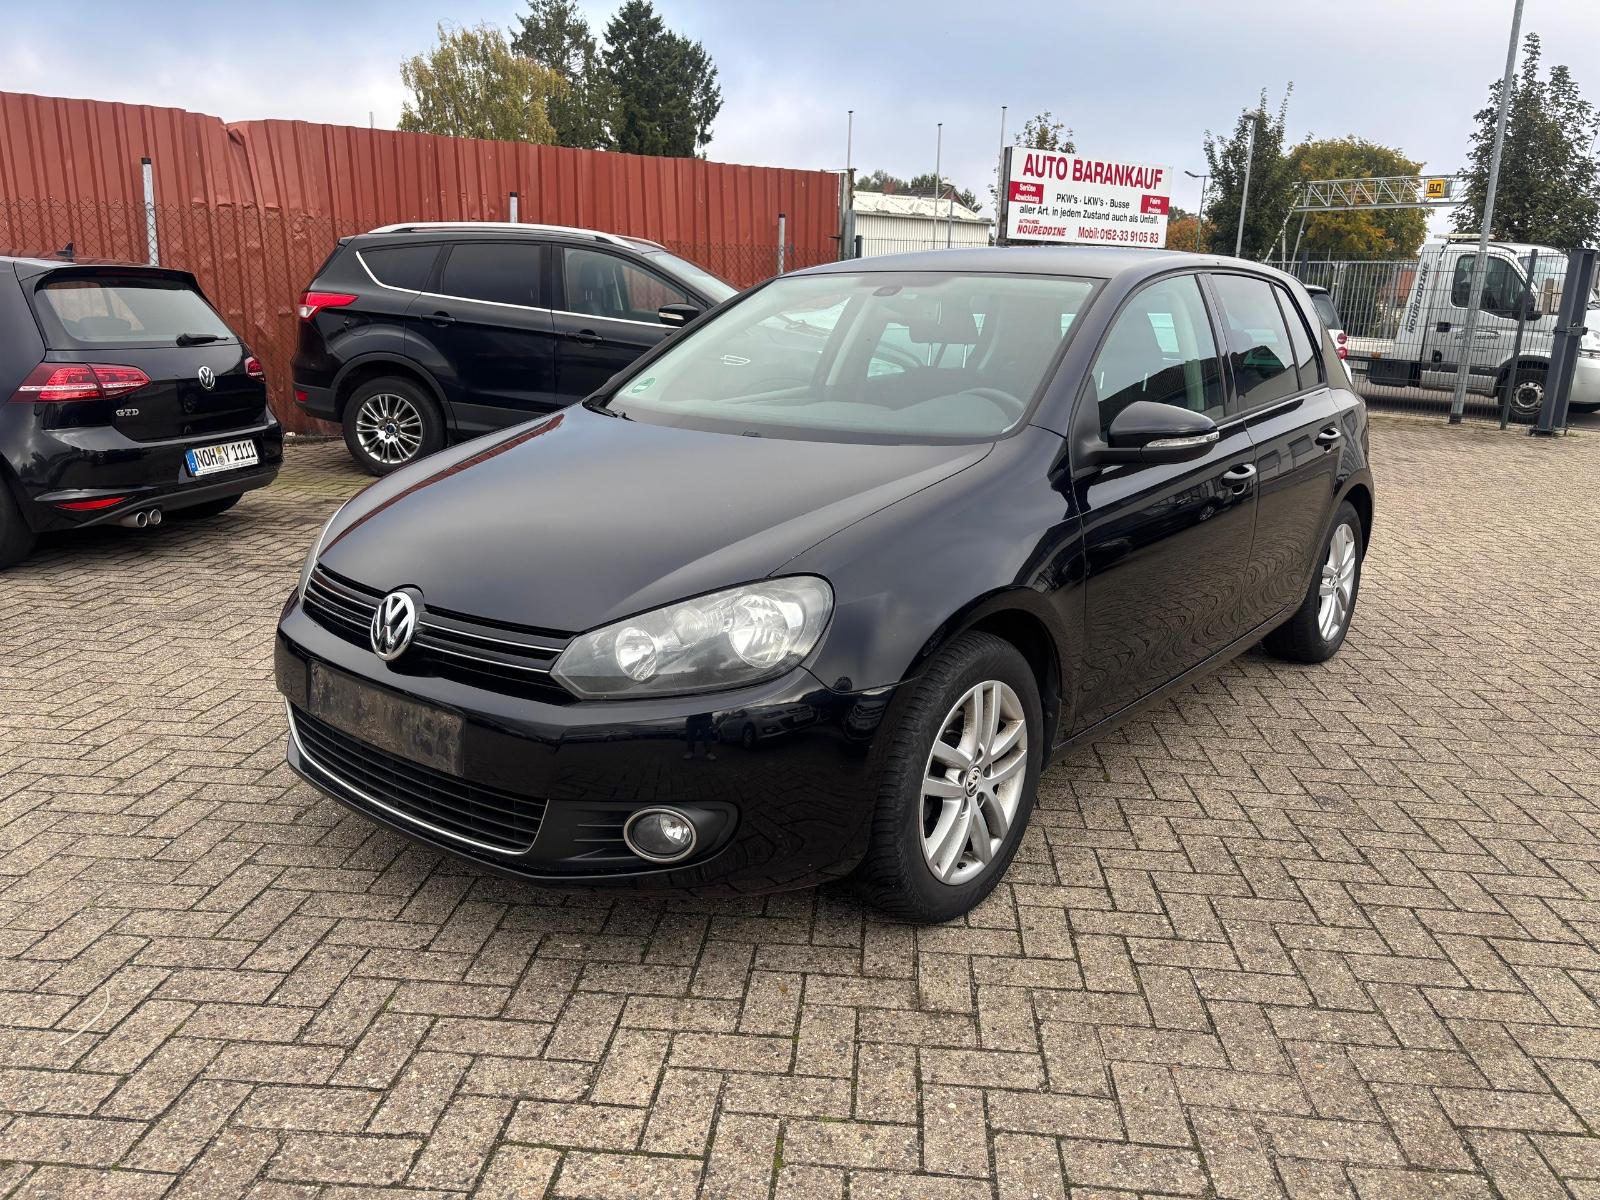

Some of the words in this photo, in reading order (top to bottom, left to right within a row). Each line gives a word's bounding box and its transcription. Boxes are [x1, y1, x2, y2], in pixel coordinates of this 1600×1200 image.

[1022, 153, 1068, 180] AUTO
[1072, 158, 1163, 190] BARANKAUF
[1056, 193, 1078, 204] PKW's
[1083, 195, 1104, 207] LKW's
[1109, 198, 1130, 209] Busse
[1019, 204, 1036, 215] aller
[1052, 206, 1059, 217] in
[1060, 207, 1082, 219] jedem
[1082, 209, 1111, 221] Zustand
[1111, 212, 1128, 222] auch
[1128, 214, 1138, 223] als
[1016, 224, 1067, 237] NOUREDDINE
[1149, 232, 1159, 244] 83
[1407, 261, 1430, 334] NOUREDDINE
[115, 408, 140, 417] GTD
[194, 447, 219, 469] NOH
[222, 445, 231, 463] Y
[230, 441, 257, 462] 1111
